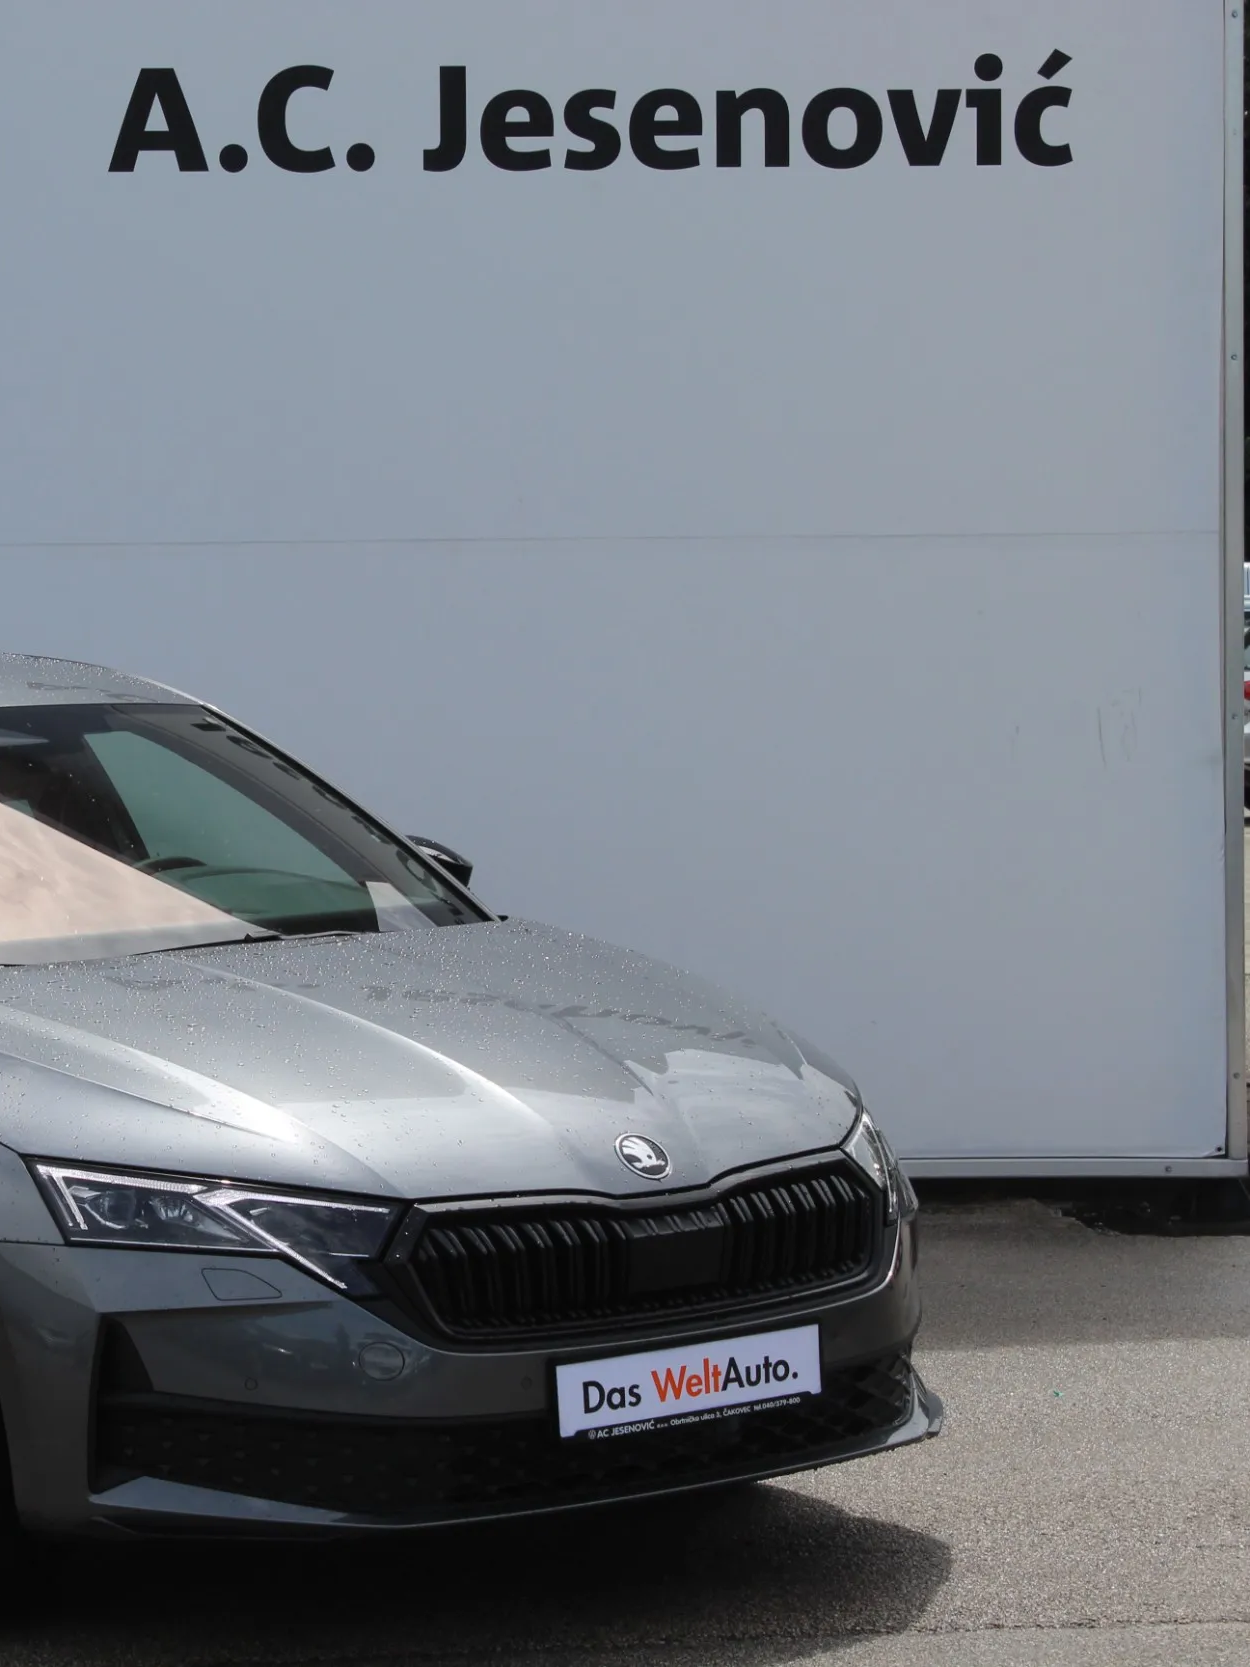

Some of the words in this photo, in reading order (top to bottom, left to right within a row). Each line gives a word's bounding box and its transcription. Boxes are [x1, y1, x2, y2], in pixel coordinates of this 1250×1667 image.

[107, 64, 376, 174] A.C.
[422, 48, 1074, 173] Jesenović
[582, 1380, 642, 1415] Das
[650, 1355, 800, 1403] WeltAuto.
[597, 1429, 610, 1439] AC
[611, 1419, 655, 1436] JESENOVIĆ
[723, 1407, 751, 1417] ČAKOVEC
